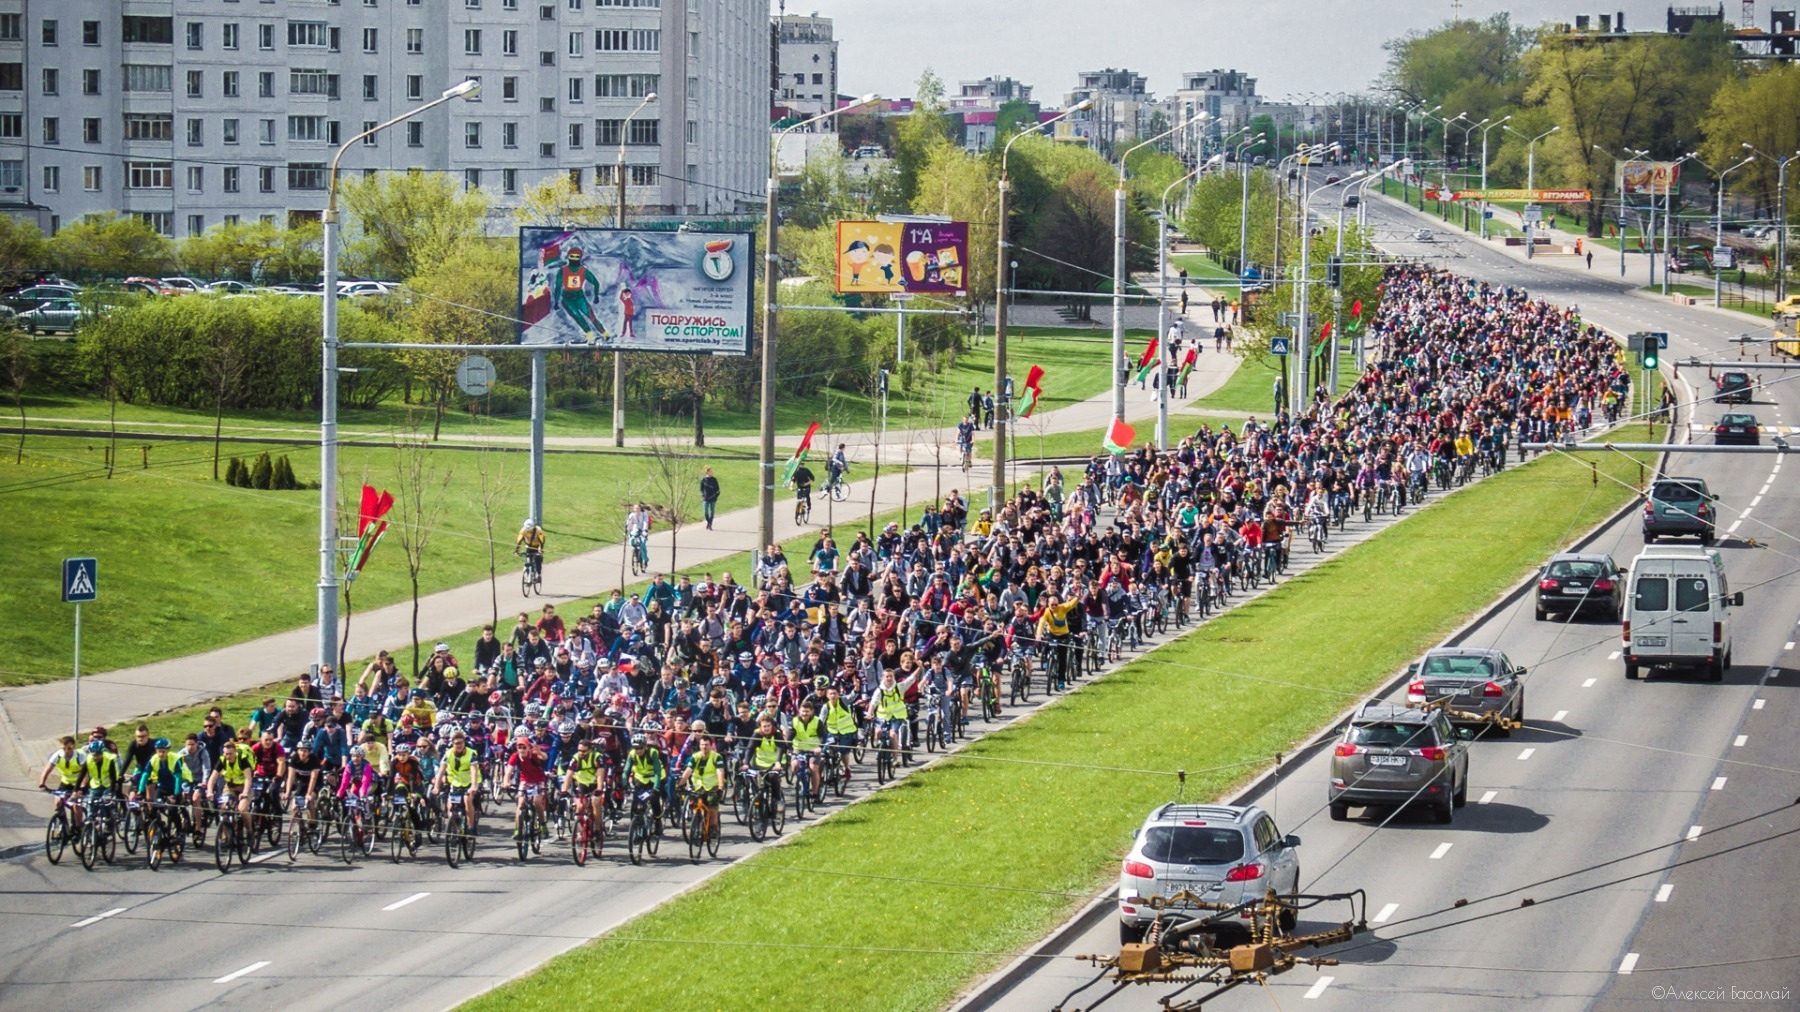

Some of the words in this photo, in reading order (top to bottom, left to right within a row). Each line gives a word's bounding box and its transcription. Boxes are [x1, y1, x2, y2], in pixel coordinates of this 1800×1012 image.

[1542, 191, 1585, 200] ВЕТЭРАНЫ!
[651, 314, 727, 327] ПОДРУЖИСЬ
[664, 325, 680, 336] СО
[683, 325, 744, 338] СПОРТОМ!
